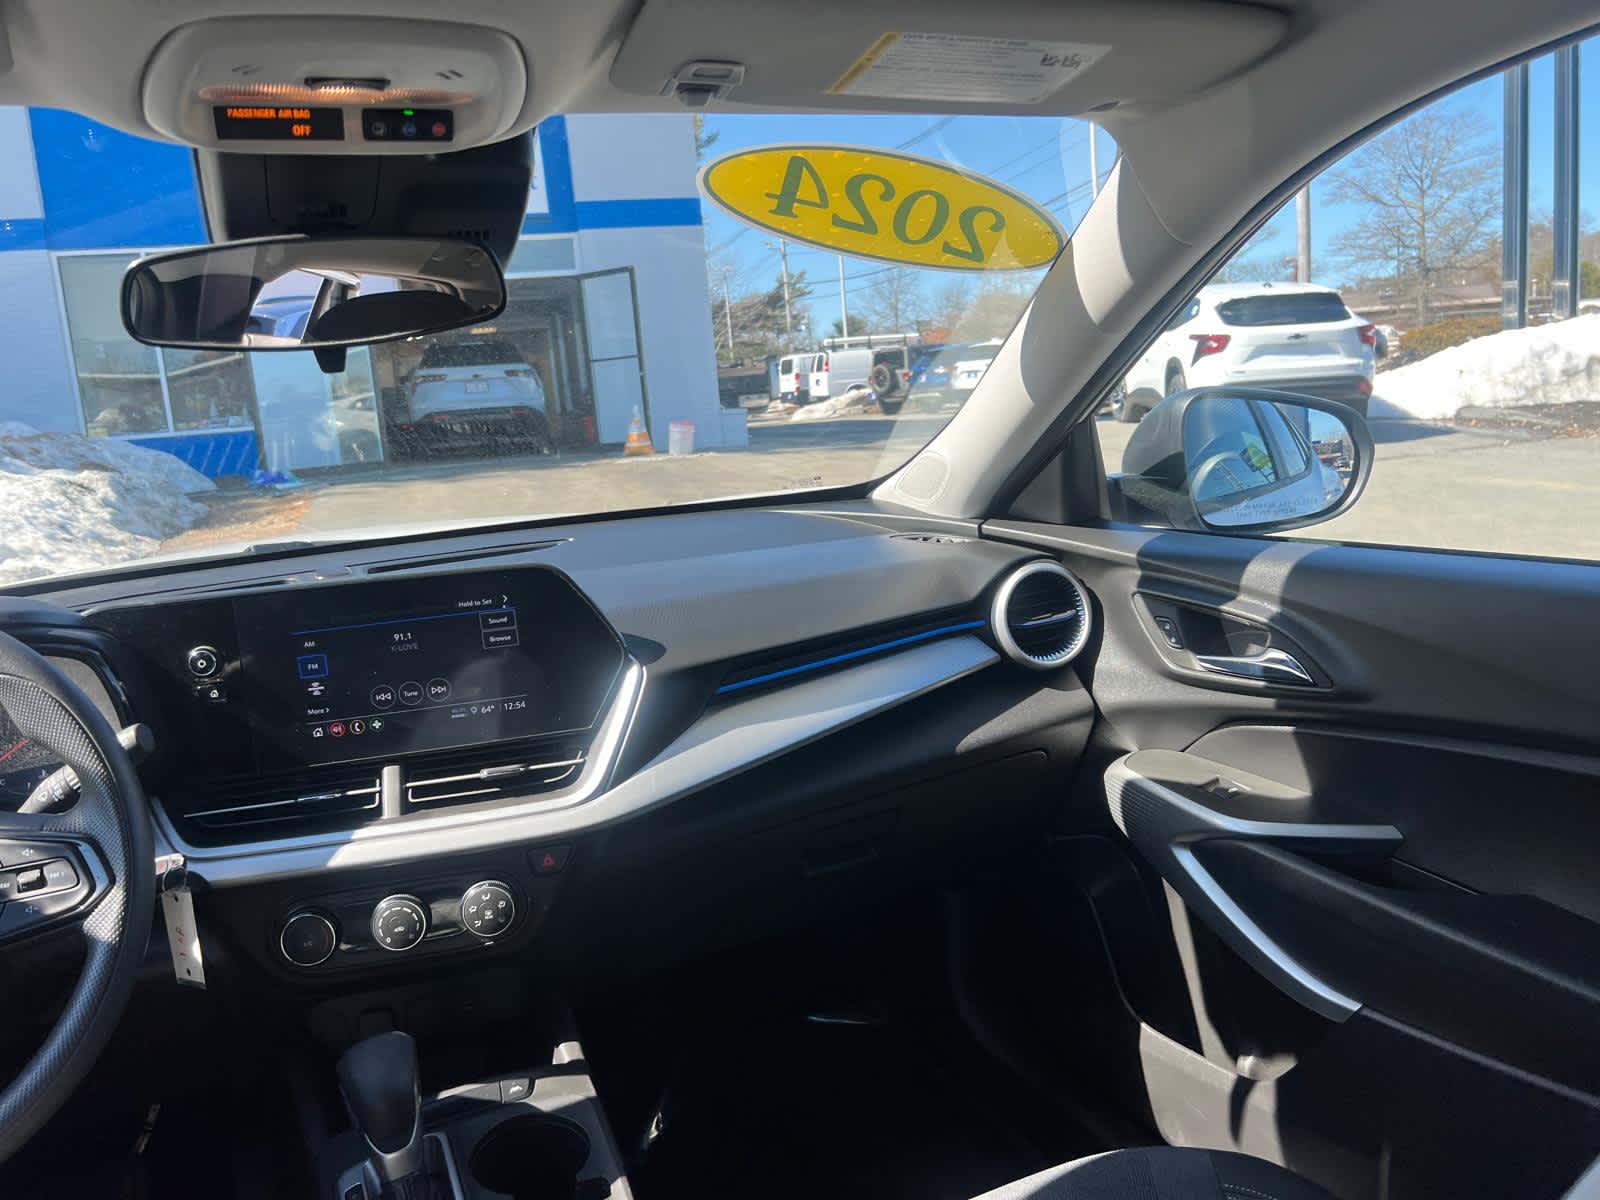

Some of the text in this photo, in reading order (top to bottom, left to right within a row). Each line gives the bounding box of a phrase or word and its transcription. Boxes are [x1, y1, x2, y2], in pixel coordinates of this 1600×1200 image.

[226, 107, 277, 119] PASSENGER
[292, 124, 312, 136] OFF
[393, 632, 412, 641] 91.1
[403, 690, 418, 698] Tune
[503, 700, 526, 711] 12:54
[307, 707, 324, 715] More
